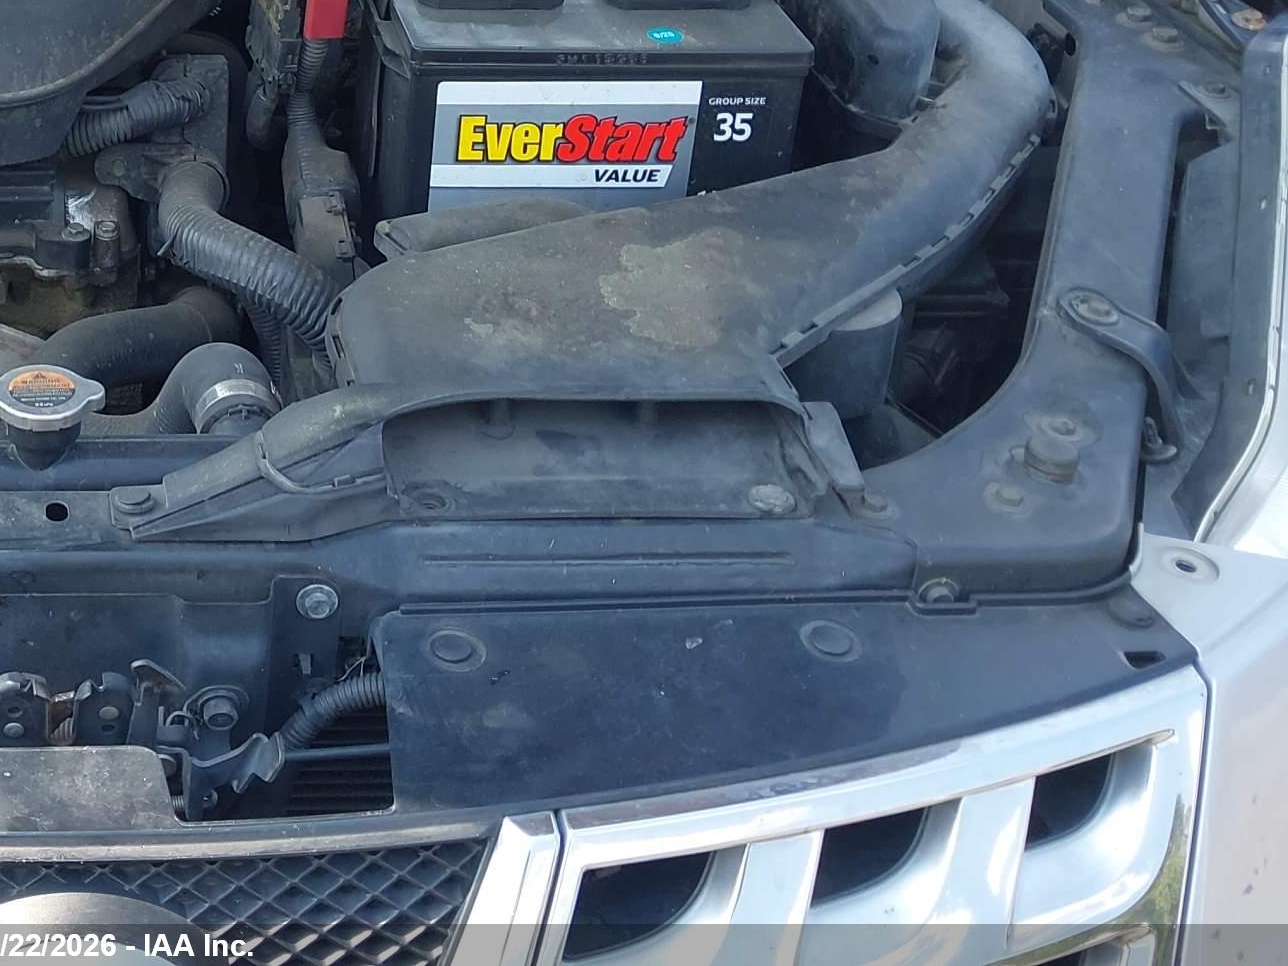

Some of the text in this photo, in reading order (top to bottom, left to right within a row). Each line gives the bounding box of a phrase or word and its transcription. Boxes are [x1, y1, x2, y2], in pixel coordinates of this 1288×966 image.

[709, 97, 767, 105] GROUP SIZE
[457, 114, 688, 162] EverStart
[713, 113, 753, 142] 35
[595, 169, 661, 183] VALUE
